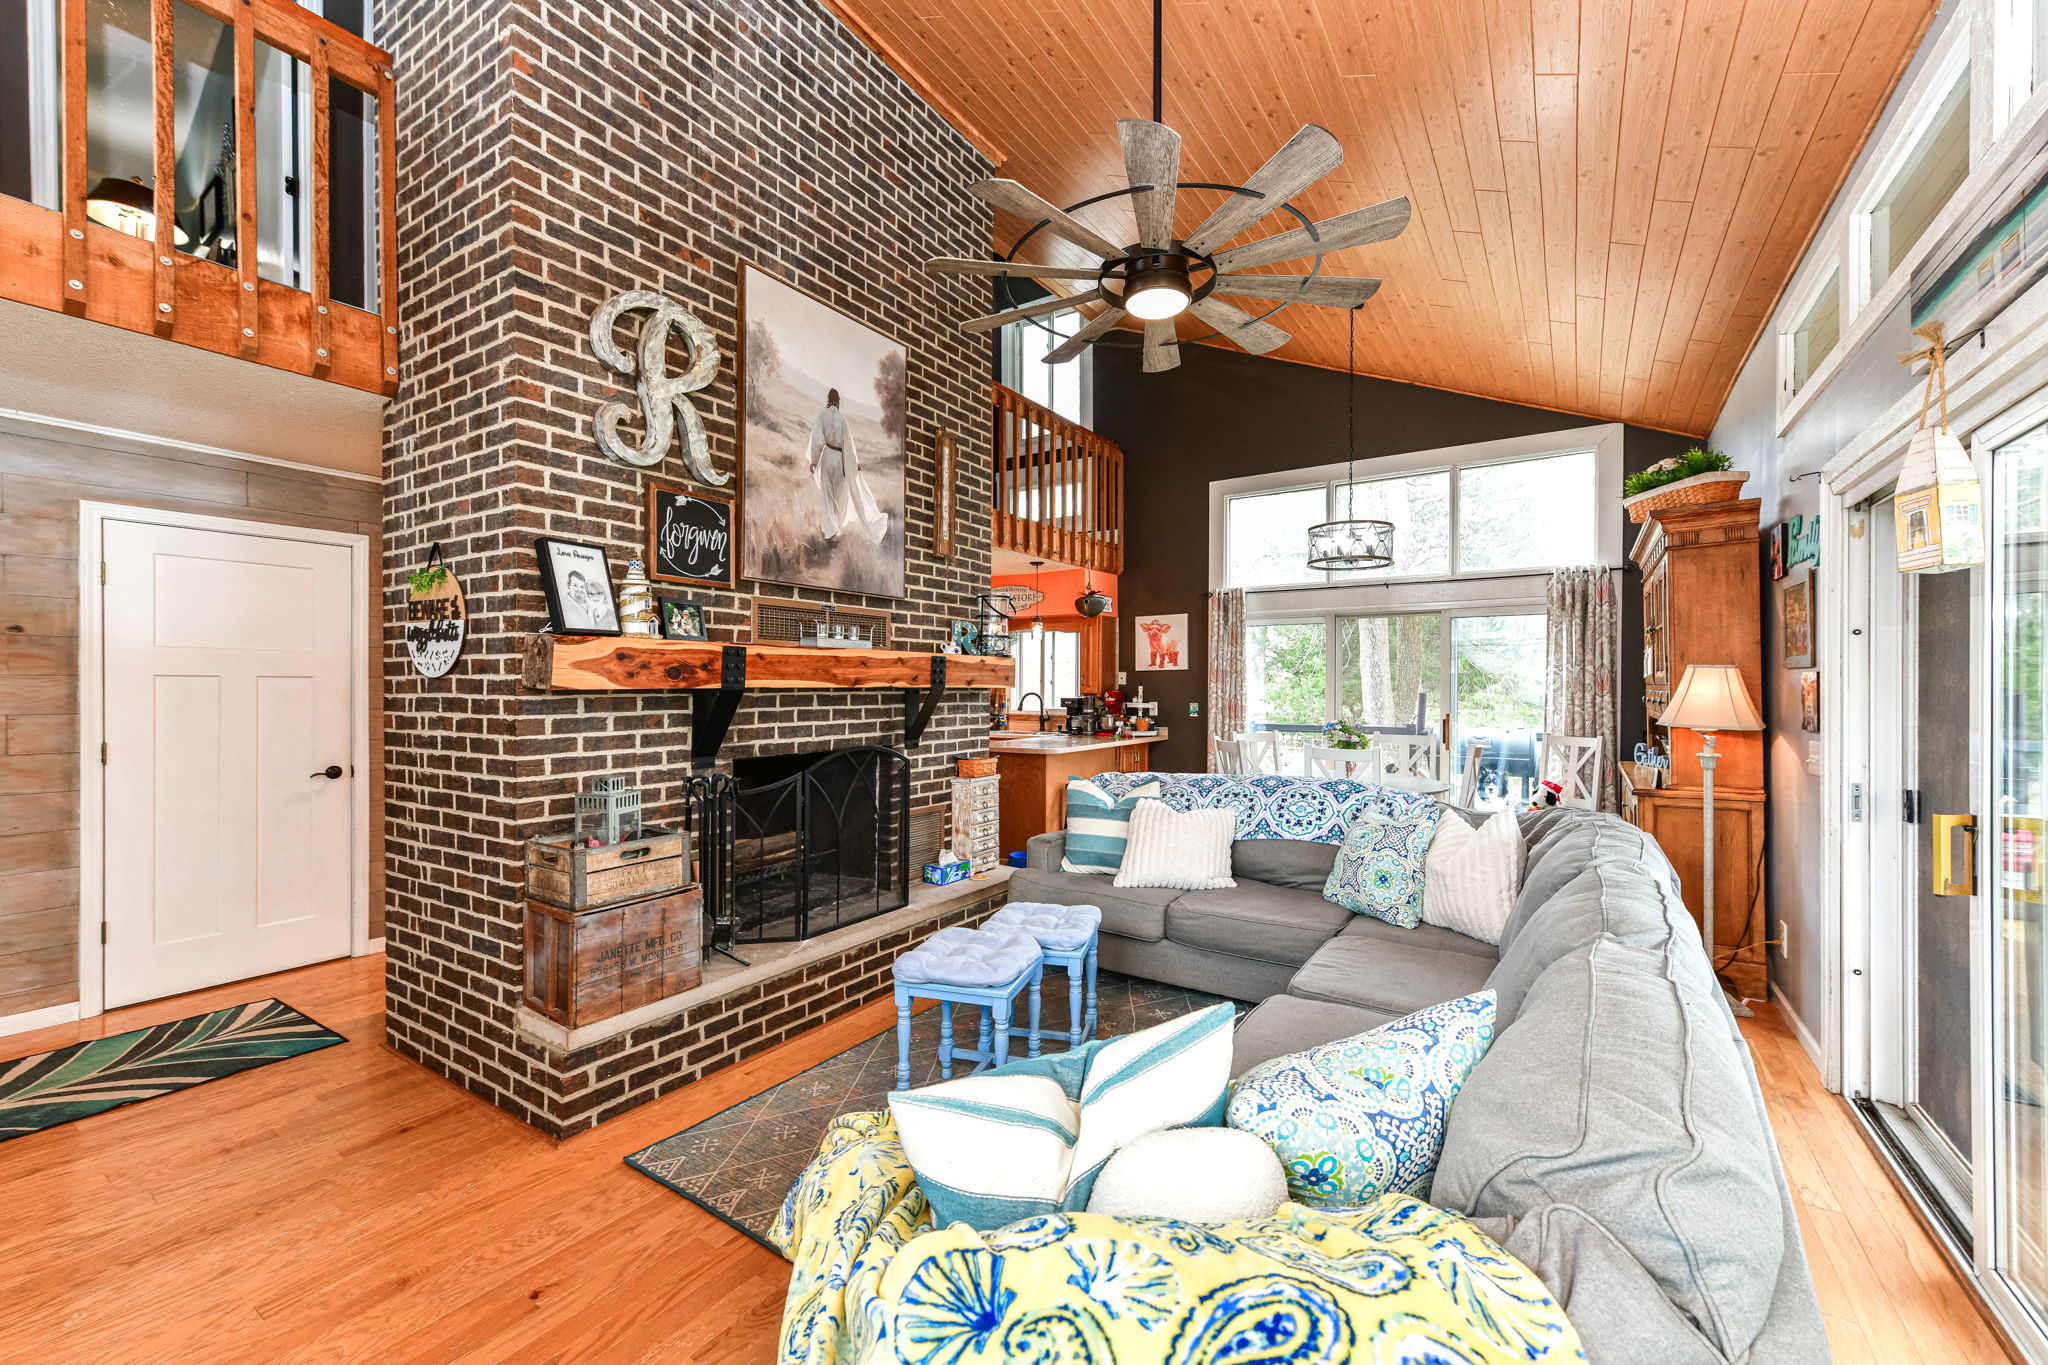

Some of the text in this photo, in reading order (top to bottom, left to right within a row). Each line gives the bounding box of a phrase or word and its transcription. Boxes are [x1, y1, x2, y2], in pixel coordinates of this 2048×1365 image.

[589, 290, 730, 486] R
[660, 506, 727, 565] forgiven
[409, 598, 450, 621] BEWARE
[1013, 593, 1037, 603] STORE
[1633, 742, 1669, 769] Gather
[597, 941, 642, 963] JANETTE
[641, 945, 676, 963] MONROE
